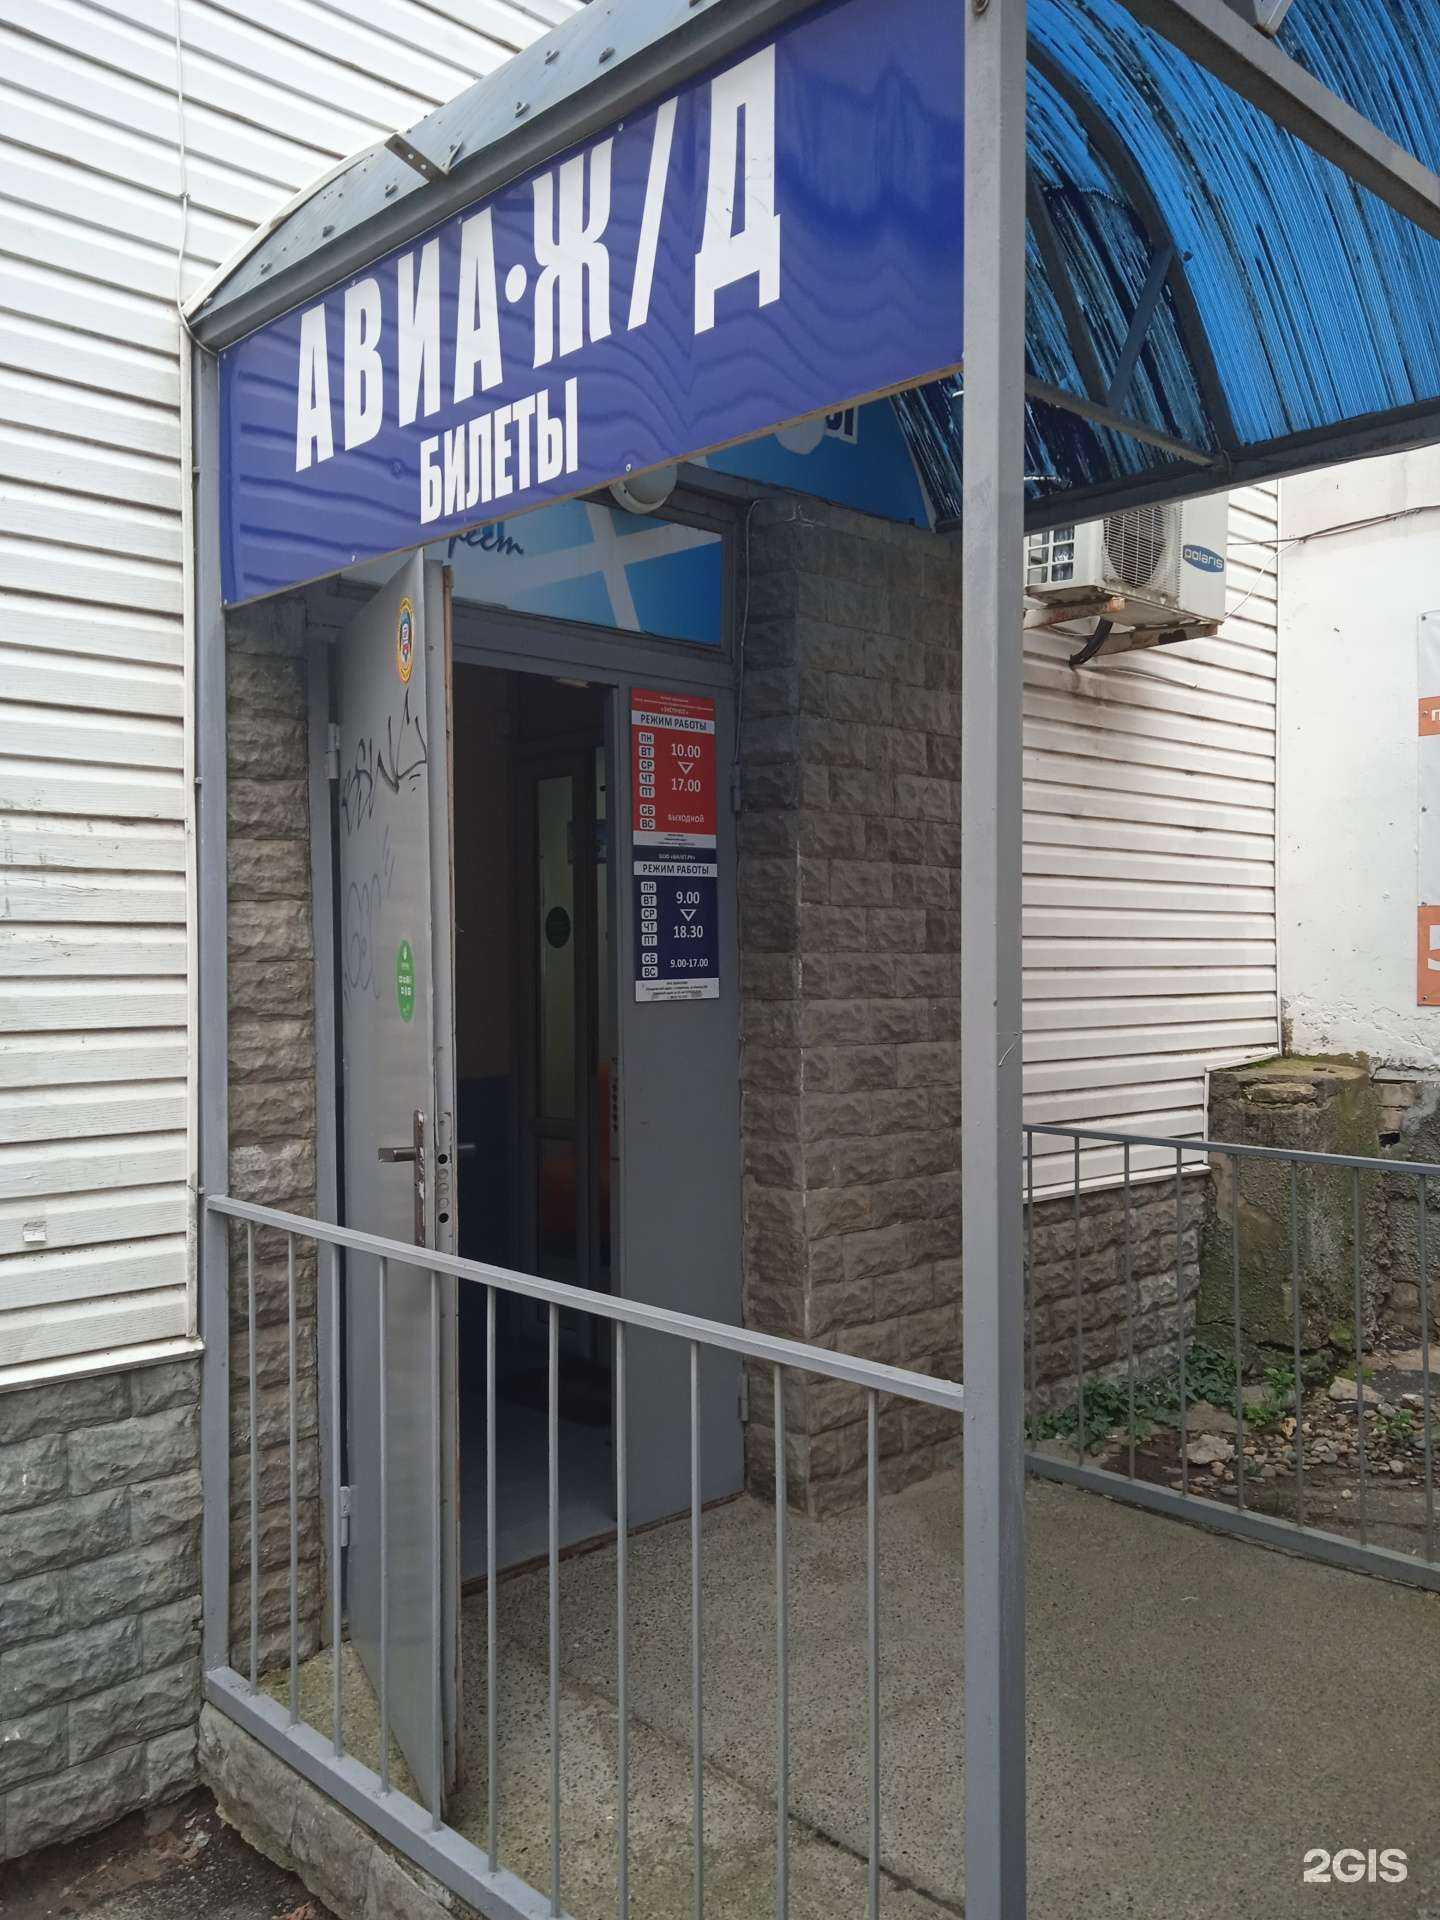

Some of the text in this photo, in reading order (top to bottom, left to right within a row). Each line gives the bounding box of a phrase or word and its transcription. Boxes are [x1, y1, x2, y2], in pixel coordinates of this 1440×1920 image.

[420, 377, 578, 525] БИЛЕТЫ
[1185, 548, 1223, 568] polaris
[640, 714, 706, 731] РЕЖИМ РАБОТЫ
[640, 735, 653, 743] ПН
[640, 748, 653, 756] ВТ
[671, 744, 701, 758] 10.00
[640, 762, 653, 770] СР
[640, 774, 653, 784] ЧТ
[671, 778, 701, 792] 17.00
[640, 788, 653, 797] ПТ
[641, 807, 654, 815] СБ
[641, 820, 654, 829] ВС
[643, 864, 709, 874] РЕЖИМ РАБОТЫ
[642, 884, 655, 892] ПН
[642, 897, 655, 905] ВТ
[676, 891, 700, 904] 9.00
[642, 910, 655, 919] СР
[643, 923, 655, 932] ЧТ
[674, 926, 704, 938] 18.30
[643, 936, 656, 945] ПТ
[643, 955, 656, 963] СБ
[644, 968, 656, 977] ВС
